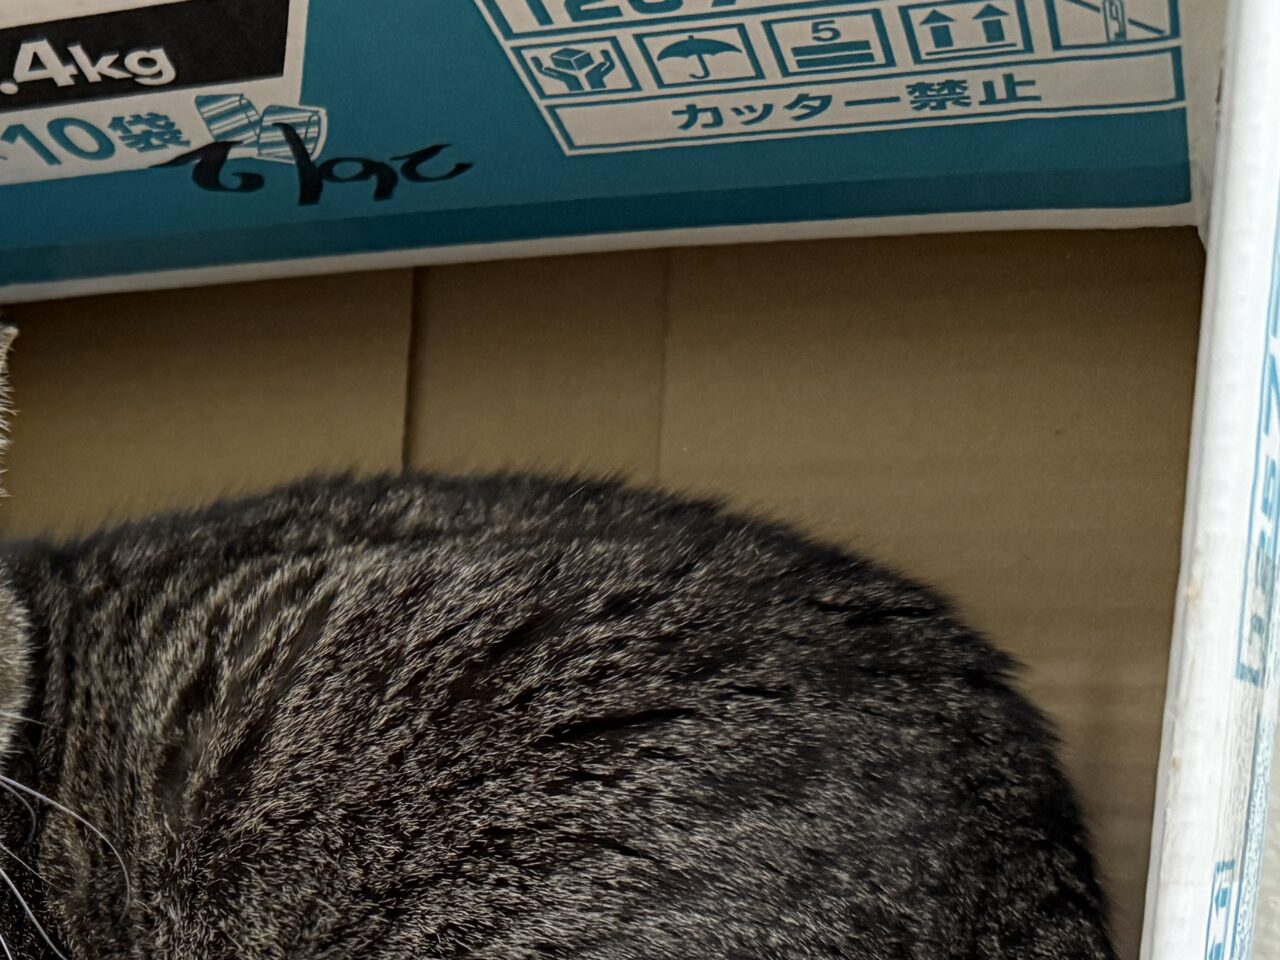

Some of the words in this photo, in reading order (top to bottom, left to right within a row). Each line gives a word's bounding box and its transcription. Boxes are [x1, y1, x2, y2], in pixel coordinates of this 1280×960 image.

[811, 19, 842, 43] 5
[671, 72, 1043, 131] カッター禁止
